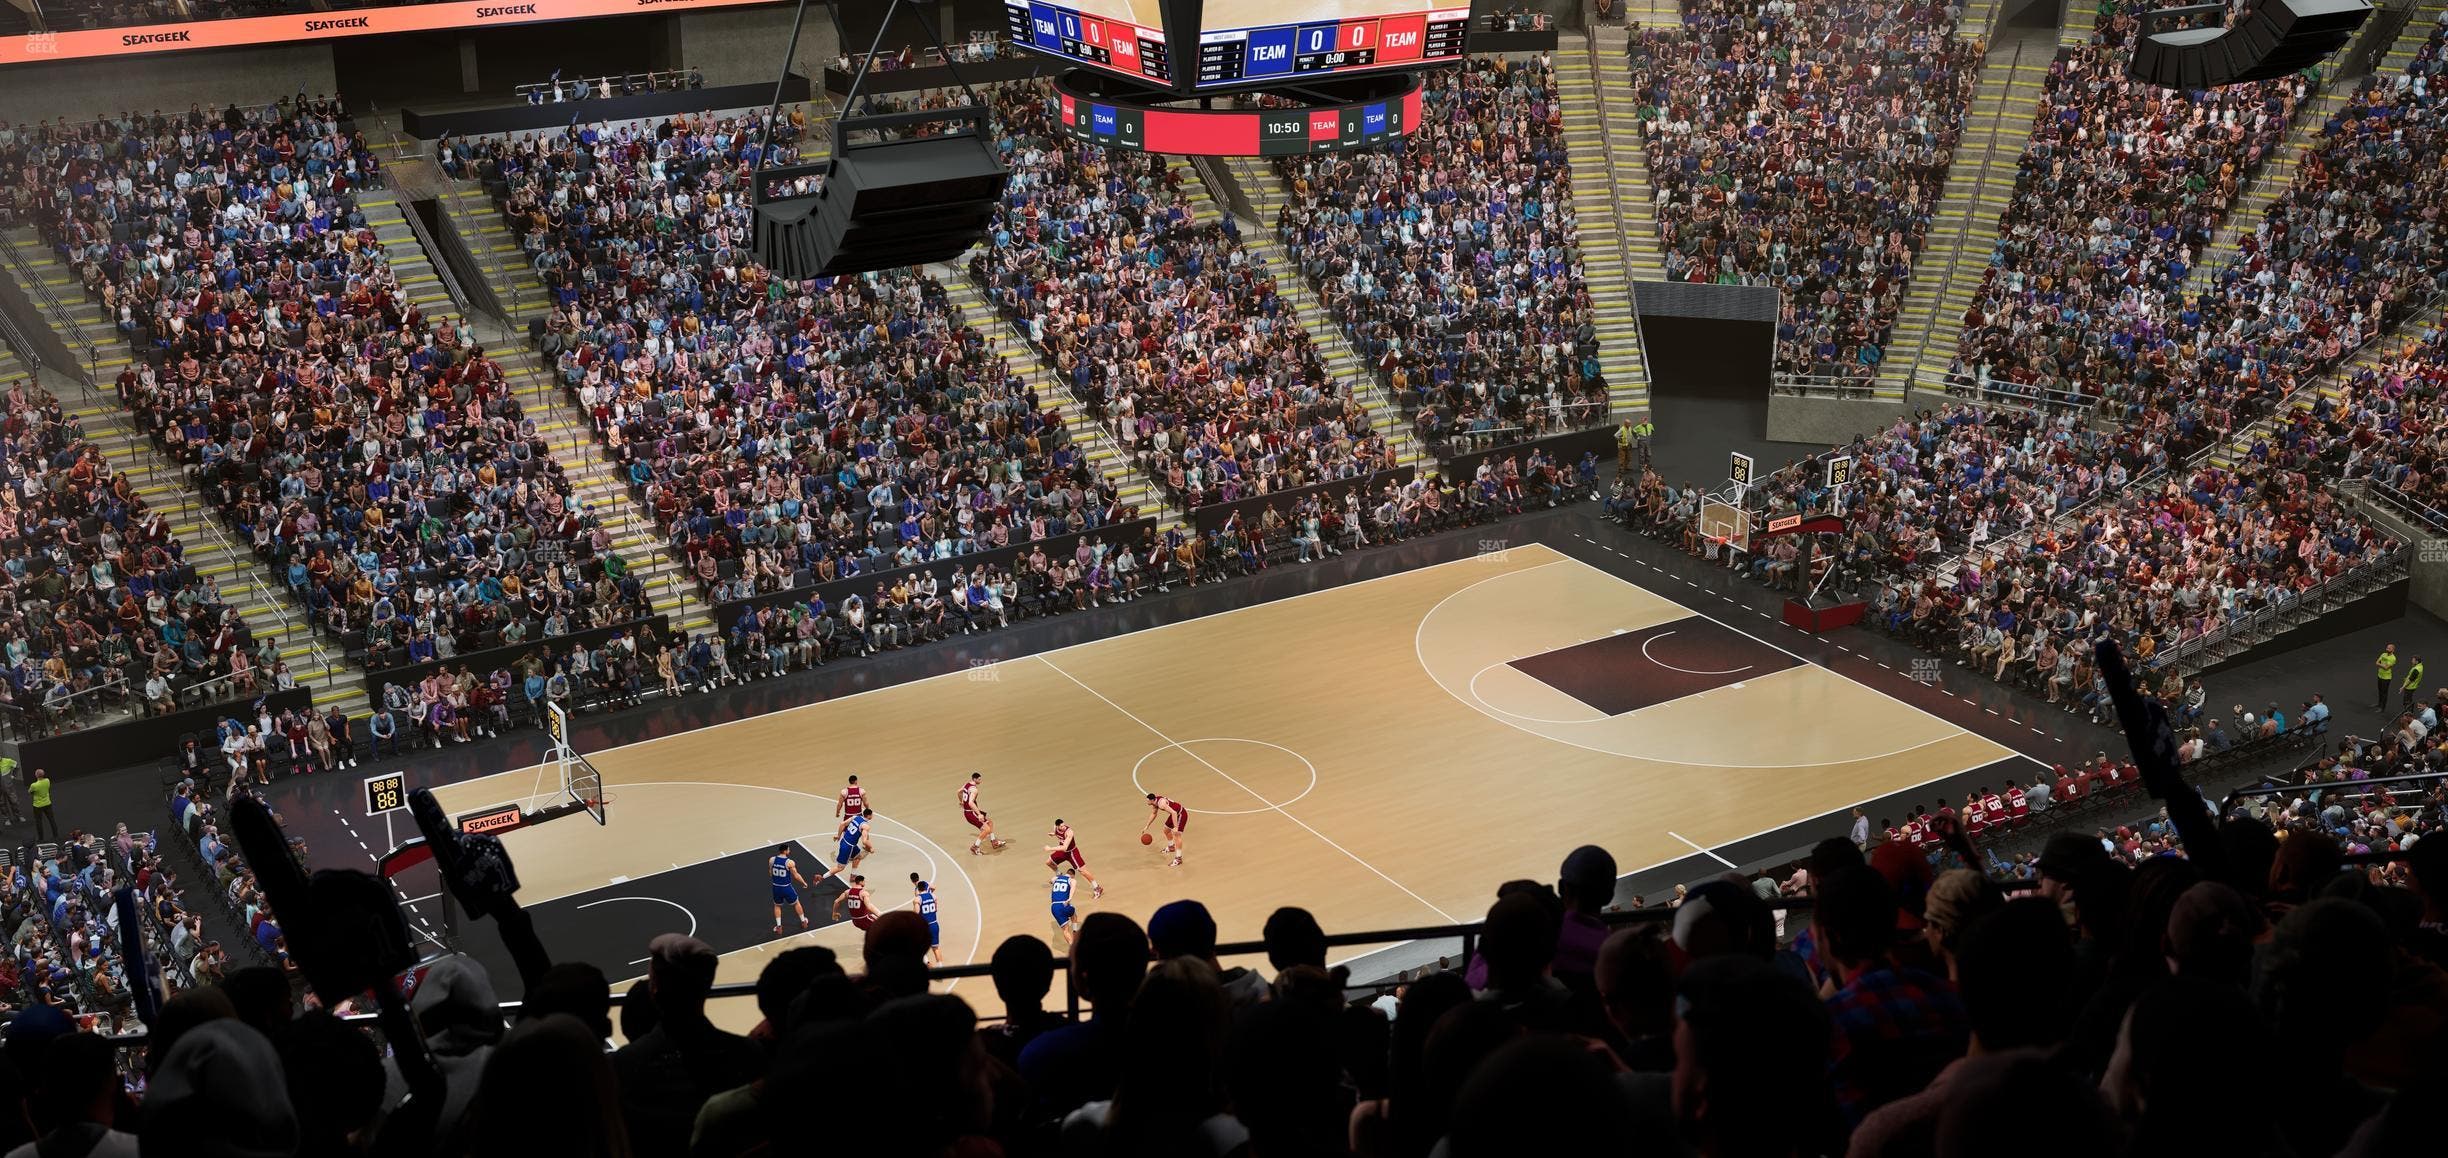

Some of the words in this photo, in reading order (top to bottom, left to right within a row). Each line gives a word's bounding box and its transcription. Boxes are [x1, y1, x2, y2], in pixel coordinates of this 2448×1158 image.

[476, 3, 536, 18] SEATGEEK
[305, 16, 369, 32] SEATGEEK
[1035, 18, 1055, 36] TEAM
[1066, 16, 1075, 37] 0
[122, 30, 191, 47] SEATGEEK
[1090, 23, 1099, 43] 0
[1352, 26, 1364, 46] 0
[1311, 30, 1323, 50] 0
[1385, 31, 1417, 48] TEAM
[1112, 38, 1134, 57] TEAM
[1253, 44, 1286, 62] TEAM
[1325, 52, 1344, 64] 0:00
[1081, 115, 1085, 125] 0
[1094, 114, 1113, 124] TEAM
[1313, 120, 1336, 130] TEAM
[1366, 114, 1384, 124] TEAM
[1393, 114, 1398, 124] 0
[1126, 123, 1132, 134] 0
[1268, 122, 1300, 134] 10:50
[1348, 122, 1354, 133] 0
[1735, 466, 1746, 481] 88
[1834, 470, 1846, 483] 88
[1772, 517, 1798, 530] SEATGEEK
[373, 781, 384, 792] 88
[386, 778, 398, 789] 88
[2067, 784, 2076, 795] 10
[378, 790, 397, 809] 88
[847, 799, 861, 807] 00
[1987, 800, 2003, 811] 00
[2012, 798, 2026, 808] 00
[468, 814, 514, 832] SEATGEEK
[1972, 814, 1984, 823] 00
[1911, 835, 1922, 843] 00
[772, 868, 786, 878] 00
[1052, 882, 1067, 892] 00
[847, 900, 860, 909] 00
[921, 903, 936, 914] 00
